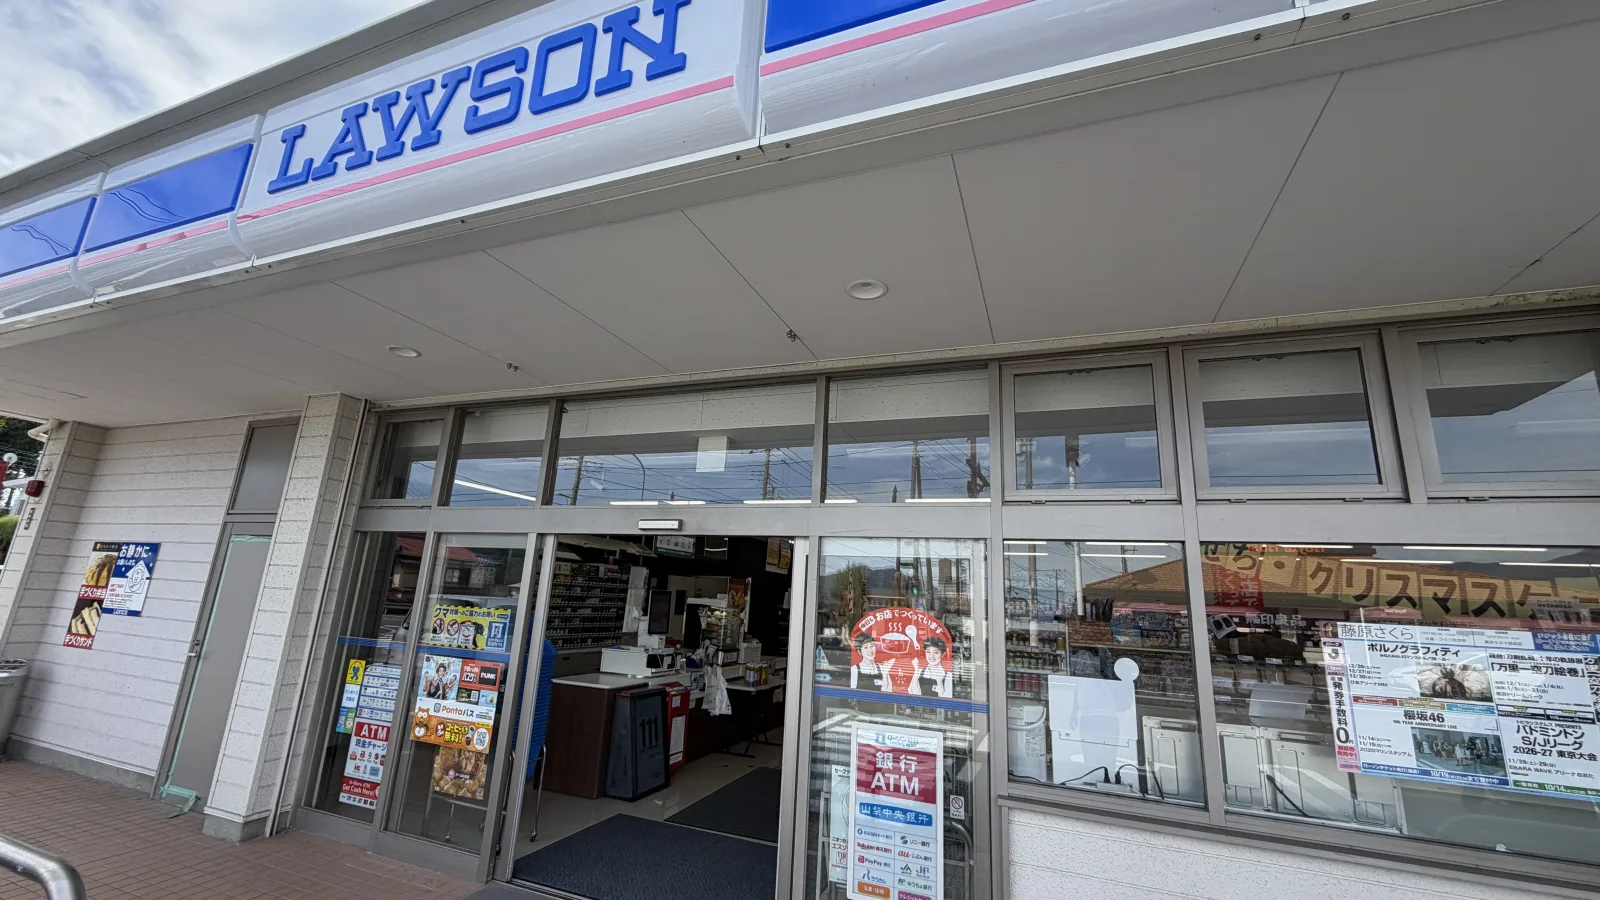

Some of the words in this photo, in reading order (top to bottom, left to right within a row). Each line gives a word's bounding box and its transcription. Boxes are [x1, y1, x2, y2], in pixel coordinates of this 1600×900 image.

[267, 0, 691, 194] LAWSON
[119, 544, 150, 559] お静かに
[80, 586, 107, 598] 手づくり弁当
[876, 609, 943, 634] お店でつくっています
[1245, 612, 1306, 627] 無印良品
[1340, 624, 1414, 640] 藤原さくら
[65, 634, 93, 648] 手づくりサンド
[1367, 643, 1461, 657] ポルノグラフィティ
[441, 705, 474, 718] Pontaパス
[1332, 681, 1348, 727] 発券手数料
[1403, 709, 1445, 723] 櫻坂46
[360, 724, 387, 740] ATM
[1516, 724, 1585, 740] バドミントン
[355, 738, 388, 751] 現金チャージ
[1521, 735, 1584, 750] S/Jリーグ
[1512, 745, 1553, 757] 2026-27
[1556, 749, 1598, 761] 東京大会
[876, 751, 918, 774] 銀行
[350, 785, 362, 794] Cash
[362, 788, 375, 797] Here!
[870, 771, 919, 796] ATM
[860, 804, 929, 824] 山梨中央銀行
[909, 839, 931, 848] ソニー銀行
[898, 850, 911, 858] au
[865, 858, 883, 867] PayPay
